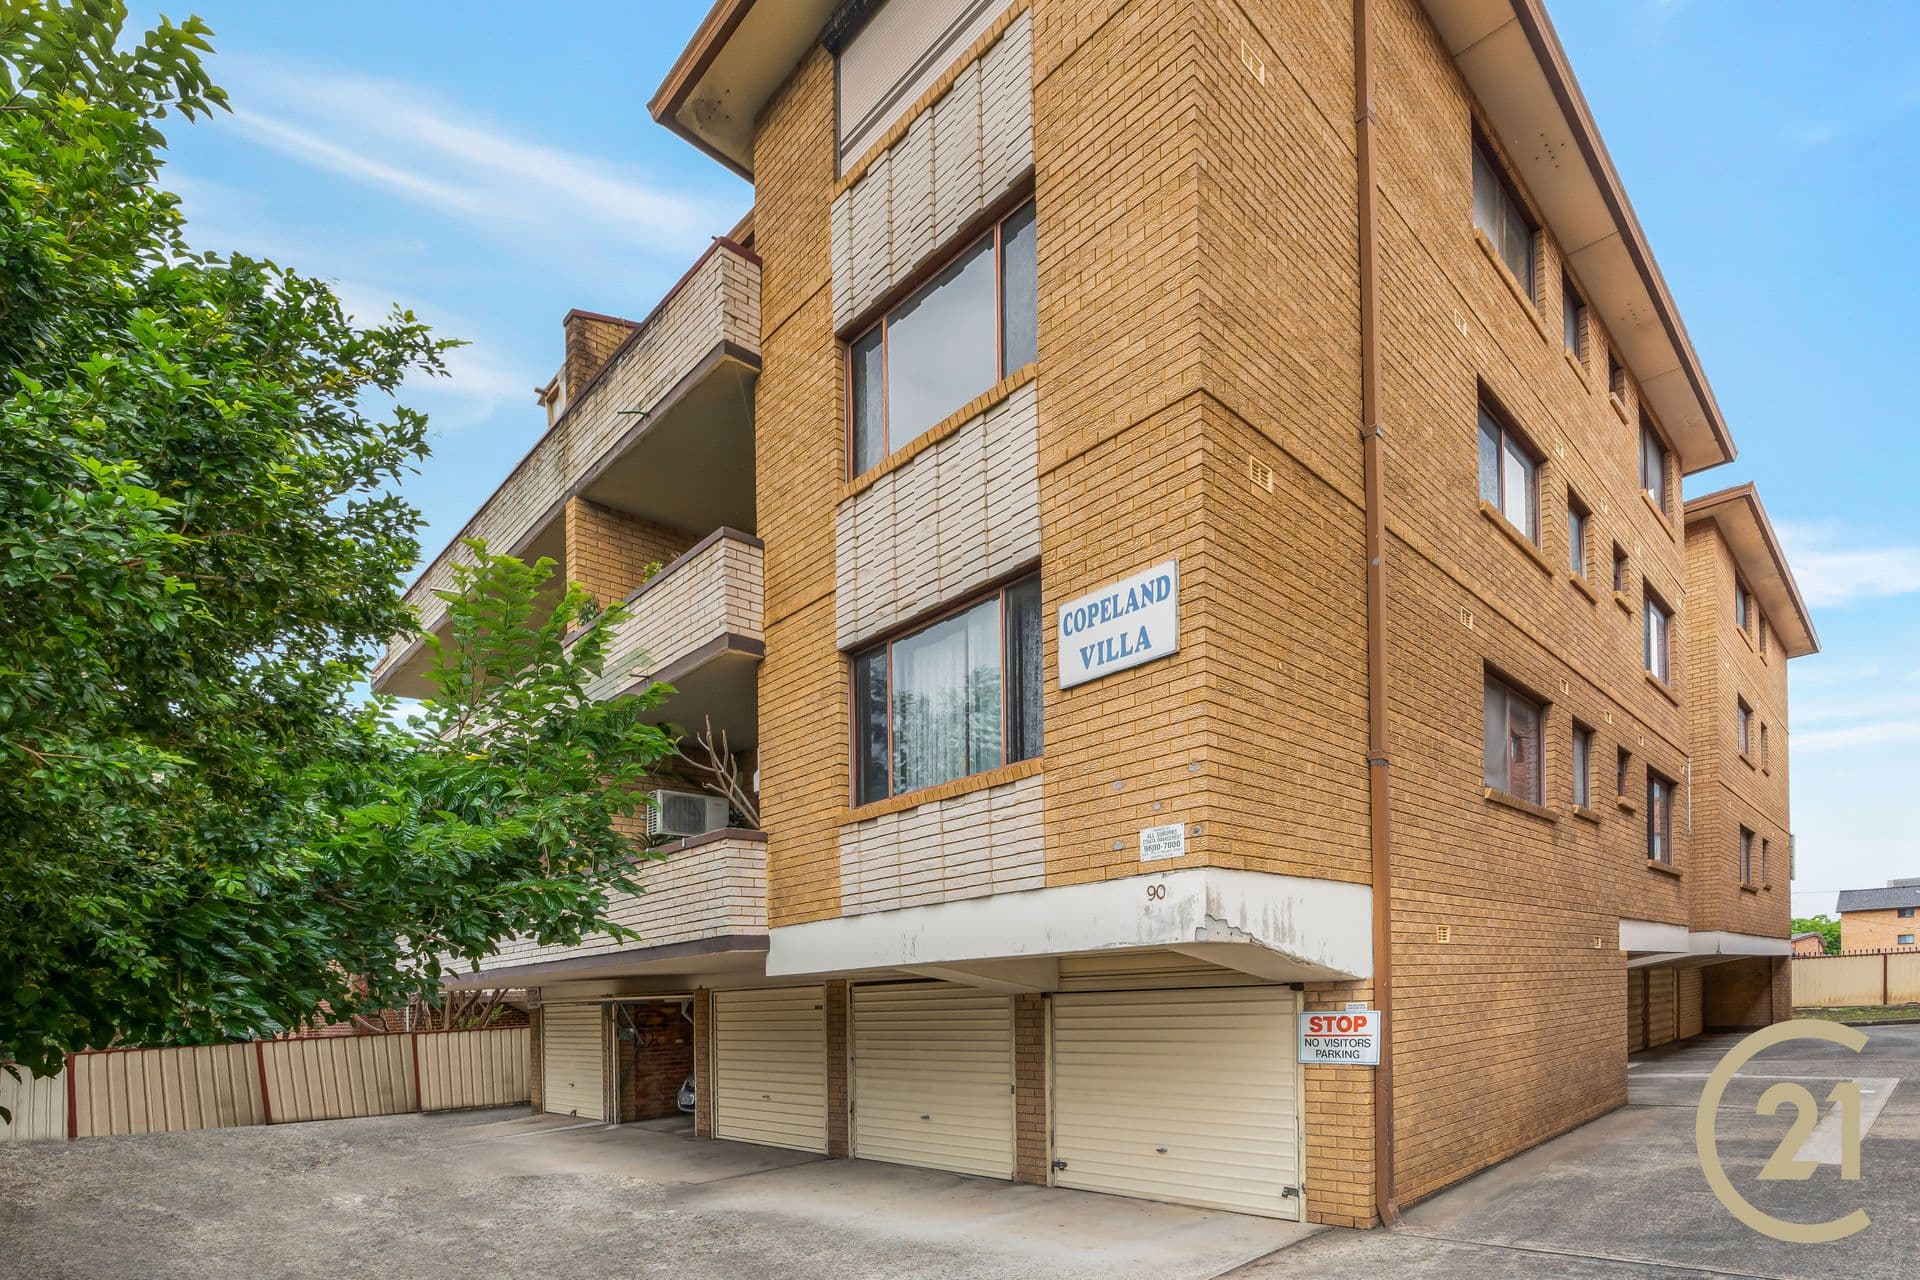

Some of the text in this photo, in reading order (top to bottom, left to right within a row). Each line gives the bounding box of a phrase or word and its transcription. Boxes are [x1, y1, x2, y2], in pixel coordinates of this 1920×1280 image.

[1063, 575, 1171, 637] COPELAND
[1080, 626, 1152, 670] VILLA
[1147, 884, 1166, 901] 90
[1309, 1016, 1367, 1033] STOP
[1304, 1038, 1371, 1048] NO VISITORS
[1315, 1050, 1360, 1059] PARKING
